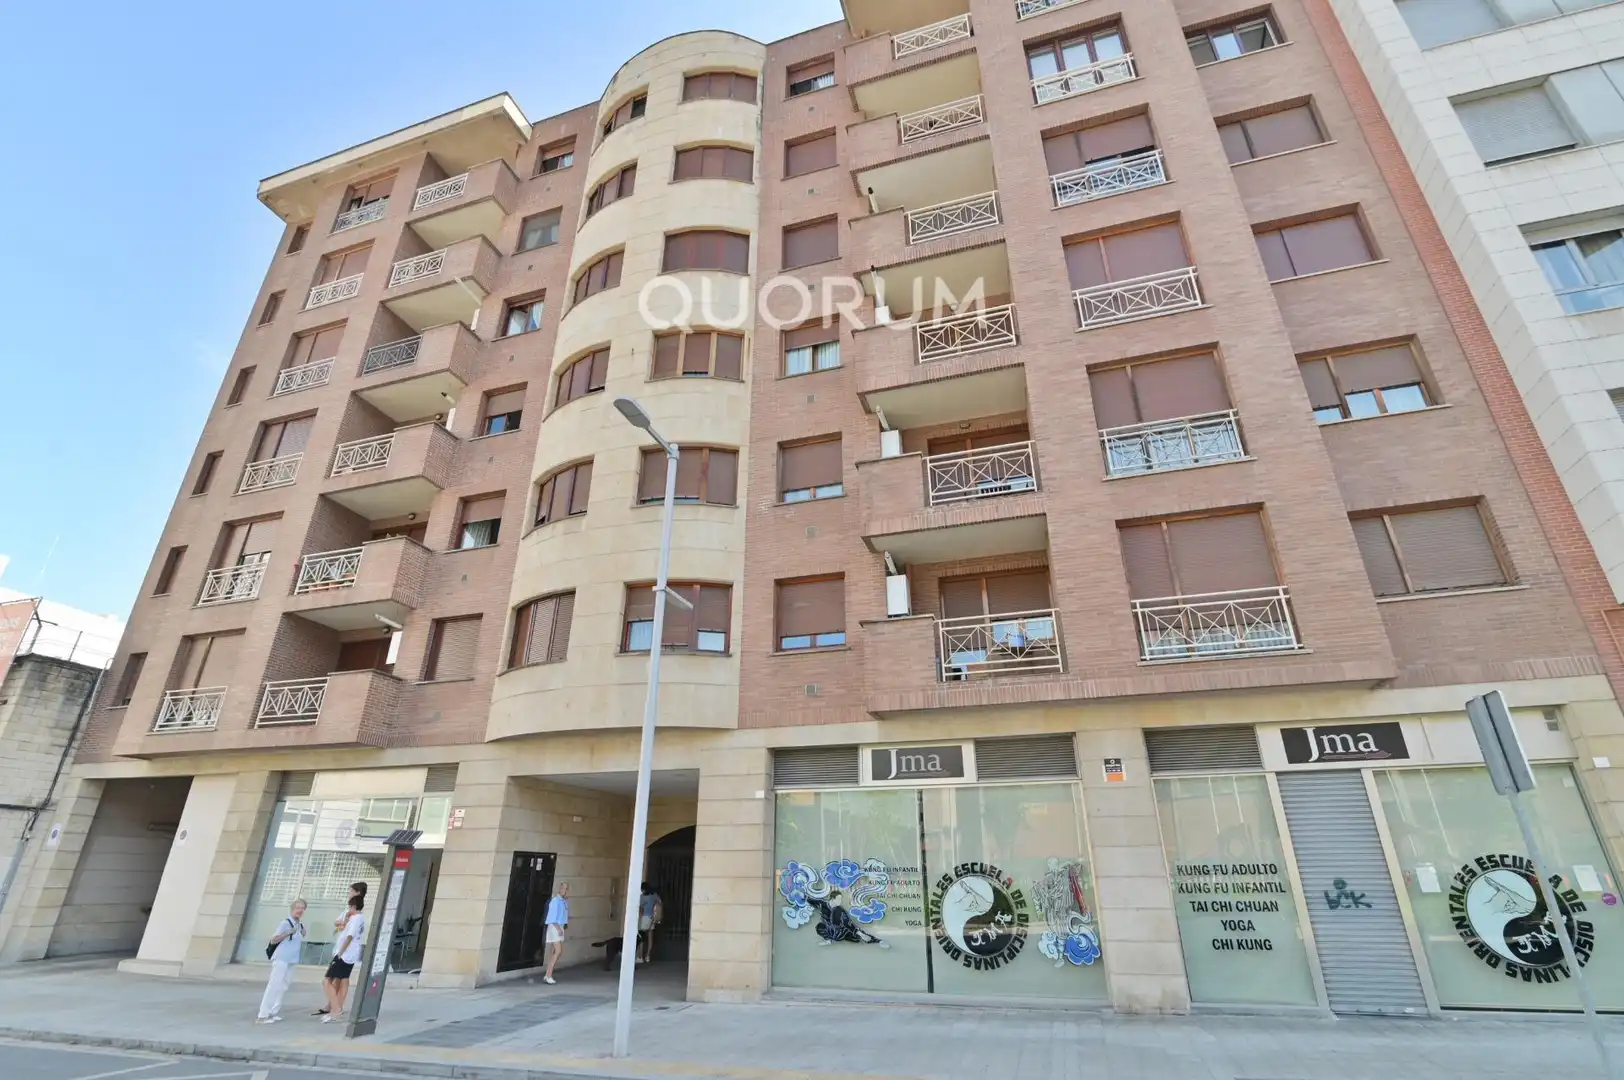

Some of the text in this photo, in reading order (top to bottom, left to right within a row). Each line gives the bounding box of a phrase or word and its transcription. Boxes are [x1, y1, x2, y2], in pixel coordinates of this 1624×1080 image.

[1302, 727, 1379, 762] Jma
[887, 748, 942, 779] Jma
[1177, 863, 1278, 876] KUNG FU ADULTO
[1178, 881, 1287, 894] KUNG FU INFANTIL
[1189, 900, 1279, 912] TAI CHI CHUAN
[905, 919, 922, 927] YOGA
[930, 862, 1030, 971] ESCUELA DE DISCIPLINAS ORIENTALES
[1448, 854, 1595, 983] ESCUEA DE DISCILINAS ORIENTALES
[1221, 919, 1256, 932] YOGA
[1212, 938, 1273, 951] CHI KUNG
